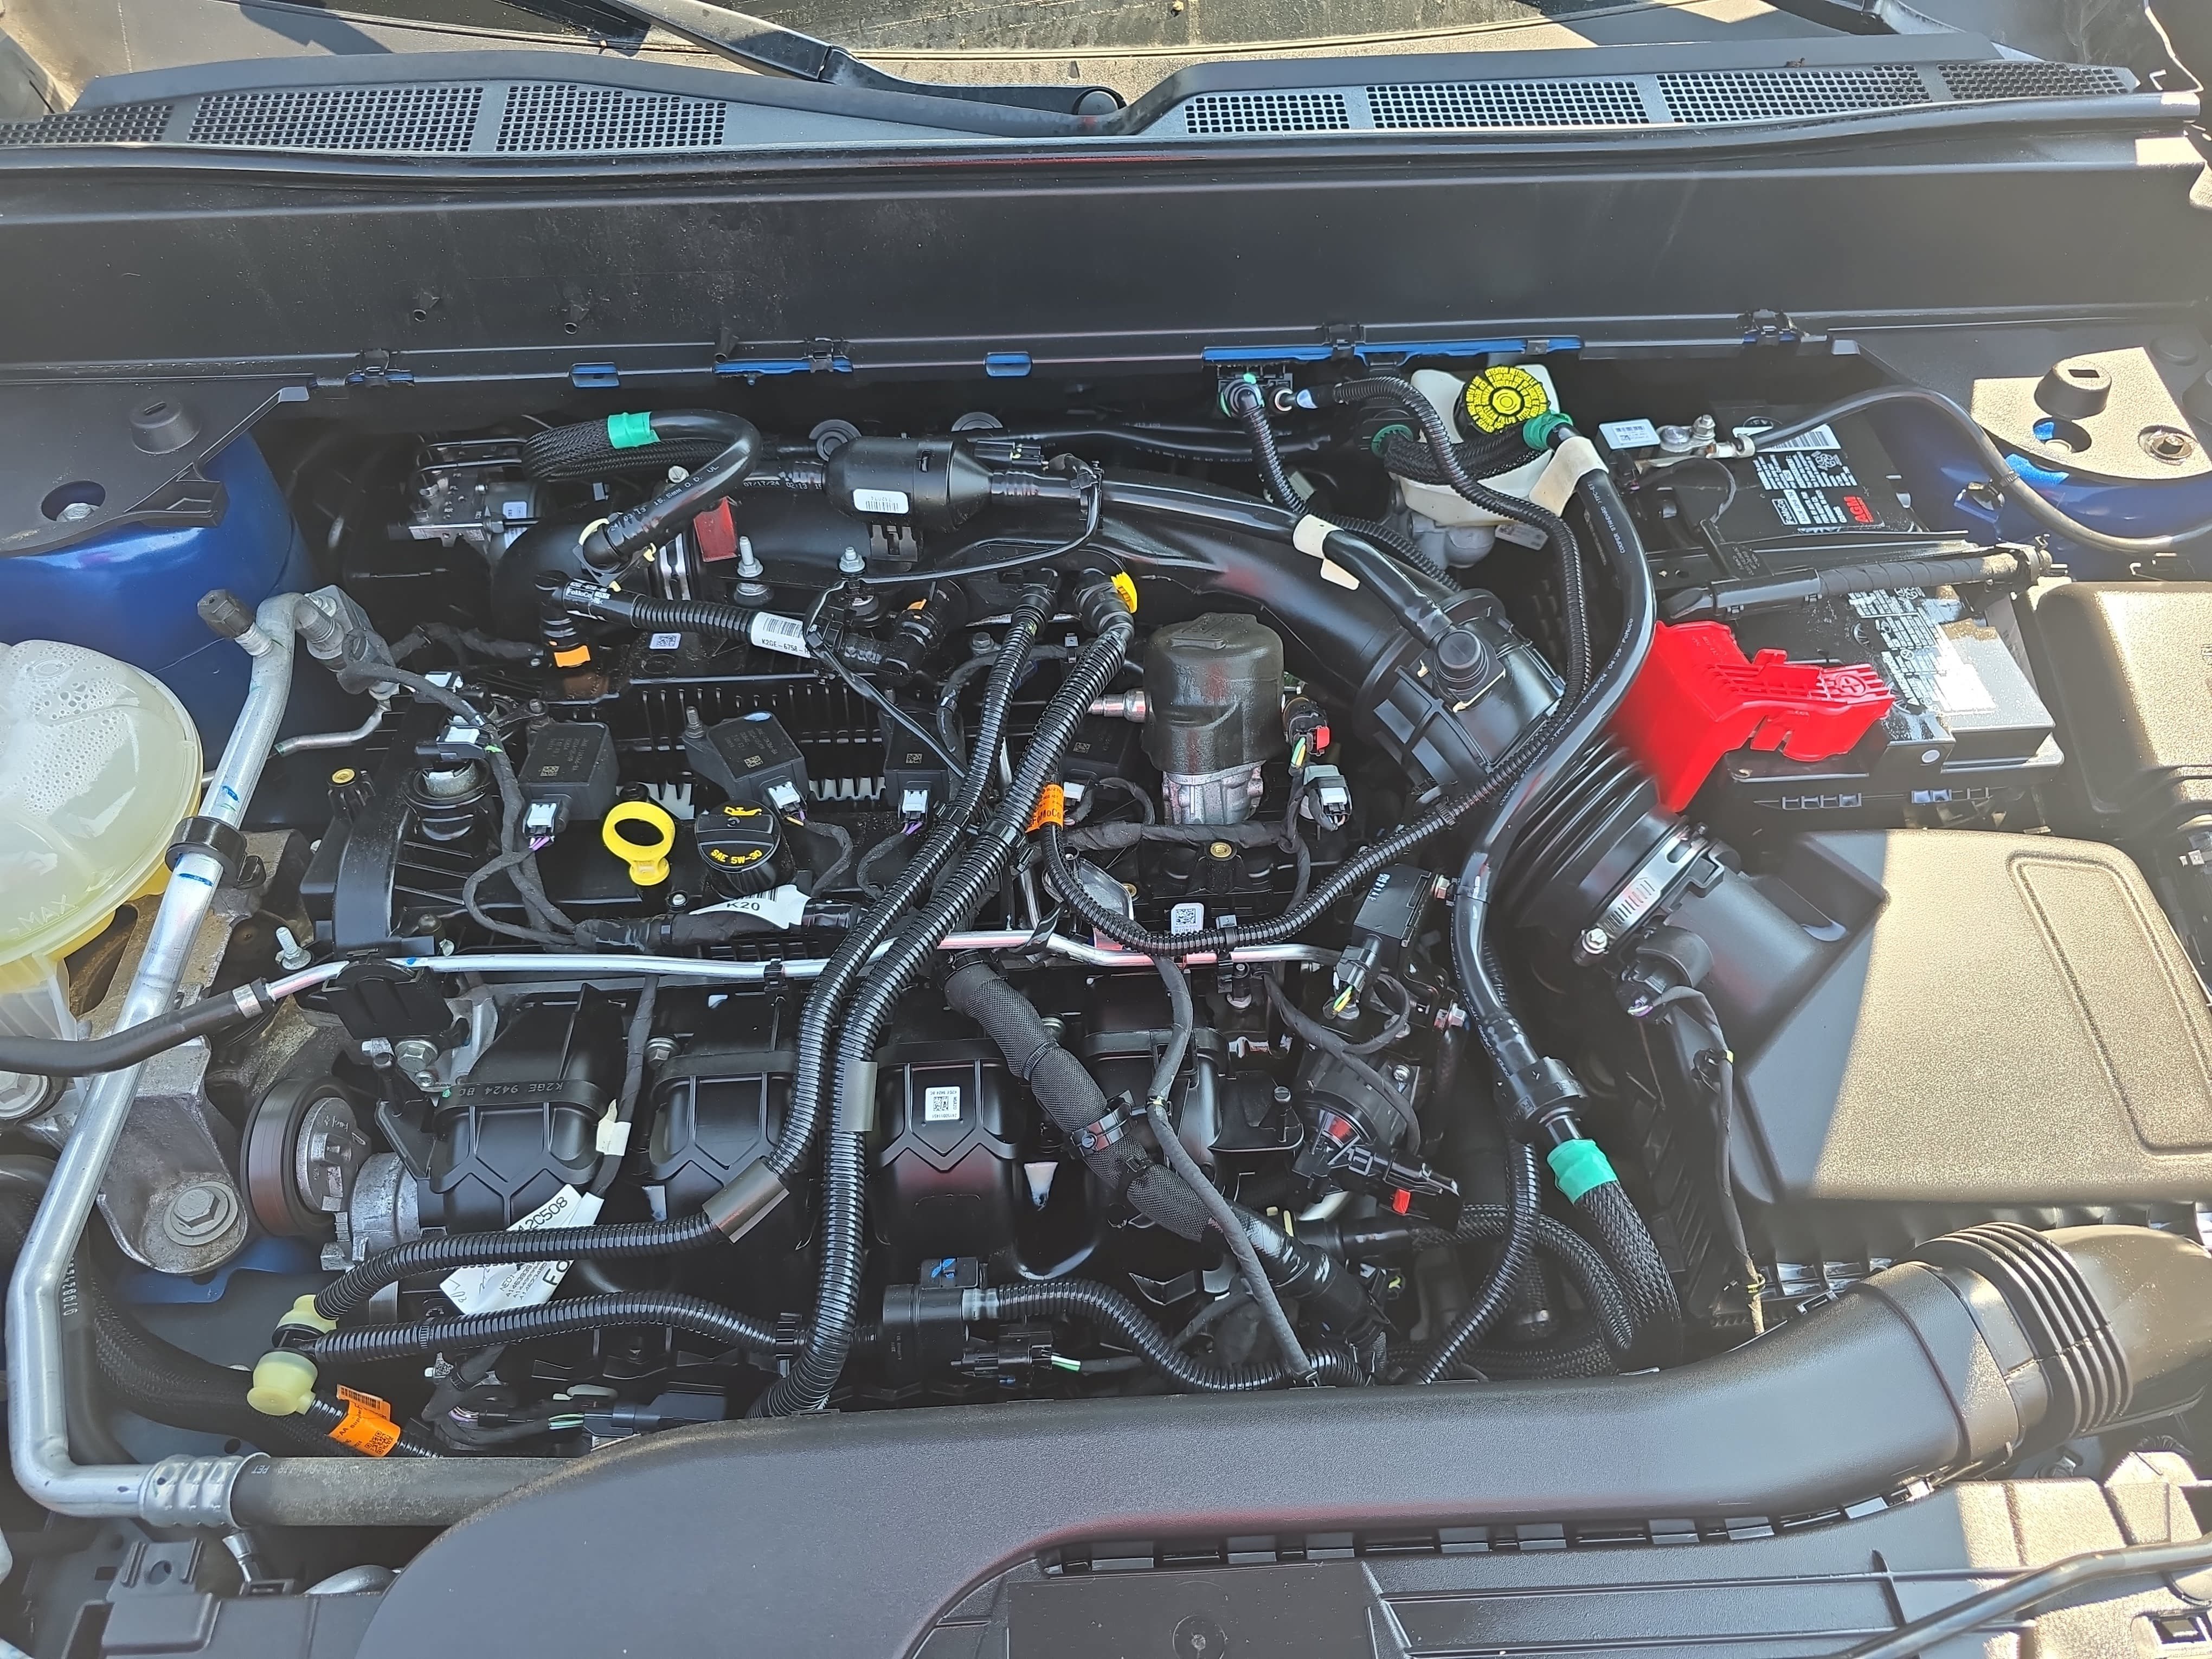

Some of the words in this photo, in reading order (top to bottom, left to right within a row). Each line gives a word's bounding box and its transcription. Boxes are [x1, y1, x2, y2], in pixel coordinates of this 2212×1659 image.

[1485, 367, 1509, 377] ATTENTION
[1509, 368, 1532, 381] NETTOYER
[1476, 406, 1495, 426] REMOVING
[1778, 500, 1793, 523] FoMoCo
[1844, 497, 1869, 523] AGM
[1613, 532, 1625, 553] COOPER
[762, 639, 777, 647] K2GE
[783, 644, 798, 652] 6758
[1519, 744, 1549, 779] STANDARD
[1622, 618, 1634, 644] FoMoCo
[1032, 808, 1061, 825] FoMoCo
[711, 849, 726, 863] SAE
[731, 850, 763, 864] 5W-30
[17, 895, 75, 931] MAX
[726, 902, 760, 911] K20
[485, 1084, 519, 1095] 9424
[528, 1082, 563, 1092] K2GE
